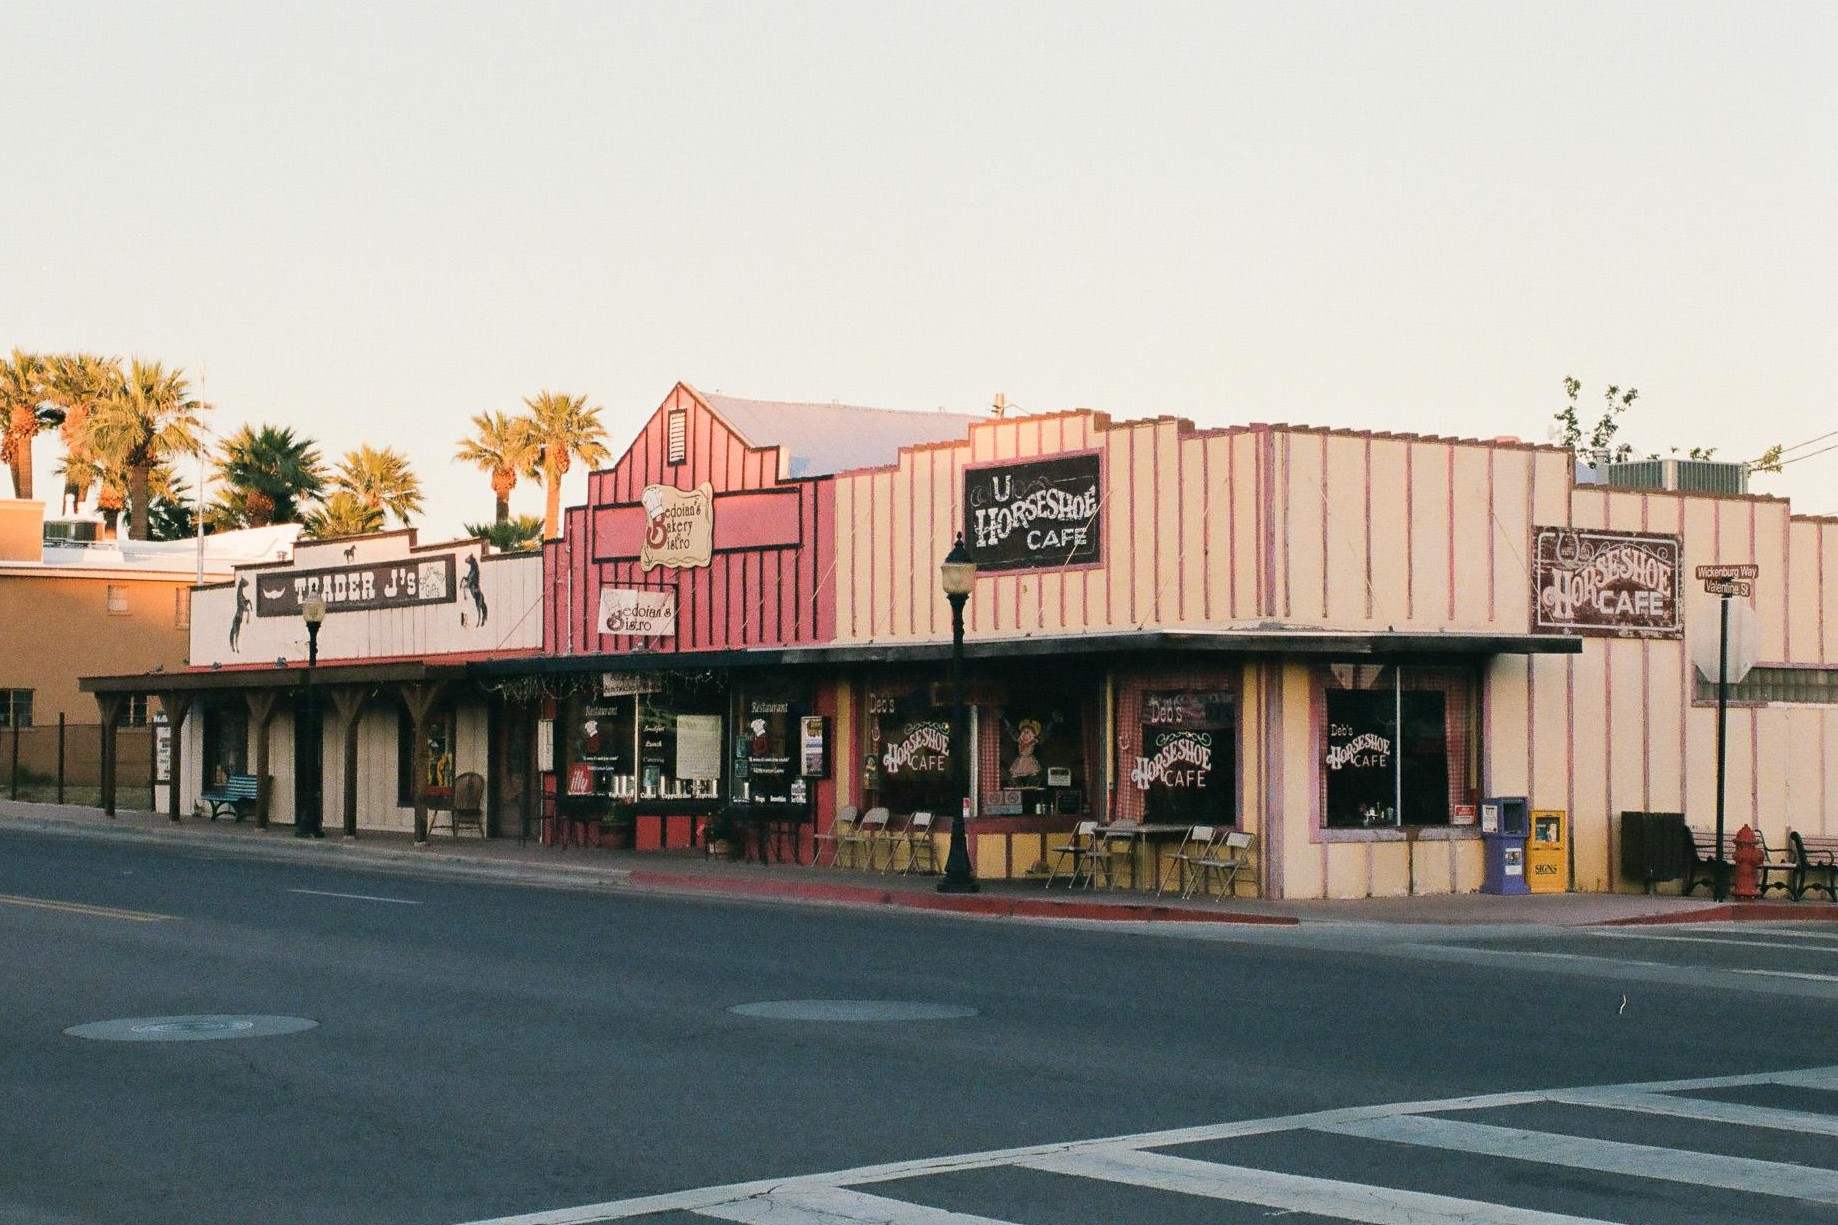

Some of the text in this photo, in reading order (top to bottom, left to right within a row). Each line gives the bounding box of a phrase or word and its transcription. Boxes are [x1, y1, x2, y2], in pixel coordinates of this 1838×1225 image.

[974, 485, 1097, 547] HORSESHOE
[1026, 528, 1087, 550] CAFE
[1542, 548, 1671, 619] HORSESHOE
[1698, 566, 1757, 579] Wickenburg Way
[294, 568, 416, 604] TRADER J's
[1706, 580, 1749, 596] Valentine St
[1599, 590, 1664, 615] CAFE
[751, 702, 788, 713] Restaurant
[1330, 723, 1353, 736] Deb's
[883, 727, 949, 773] HORSESHOE
[1326, 733, 1391, 769] HORSESHOE
[1354, 754, 1386, 767] CAFE
[911, 755, 945, 770] CAFE
[1131, 738, 1212, 789] HORSESHOE
[1165, 770, 1206, 787] CAFE
